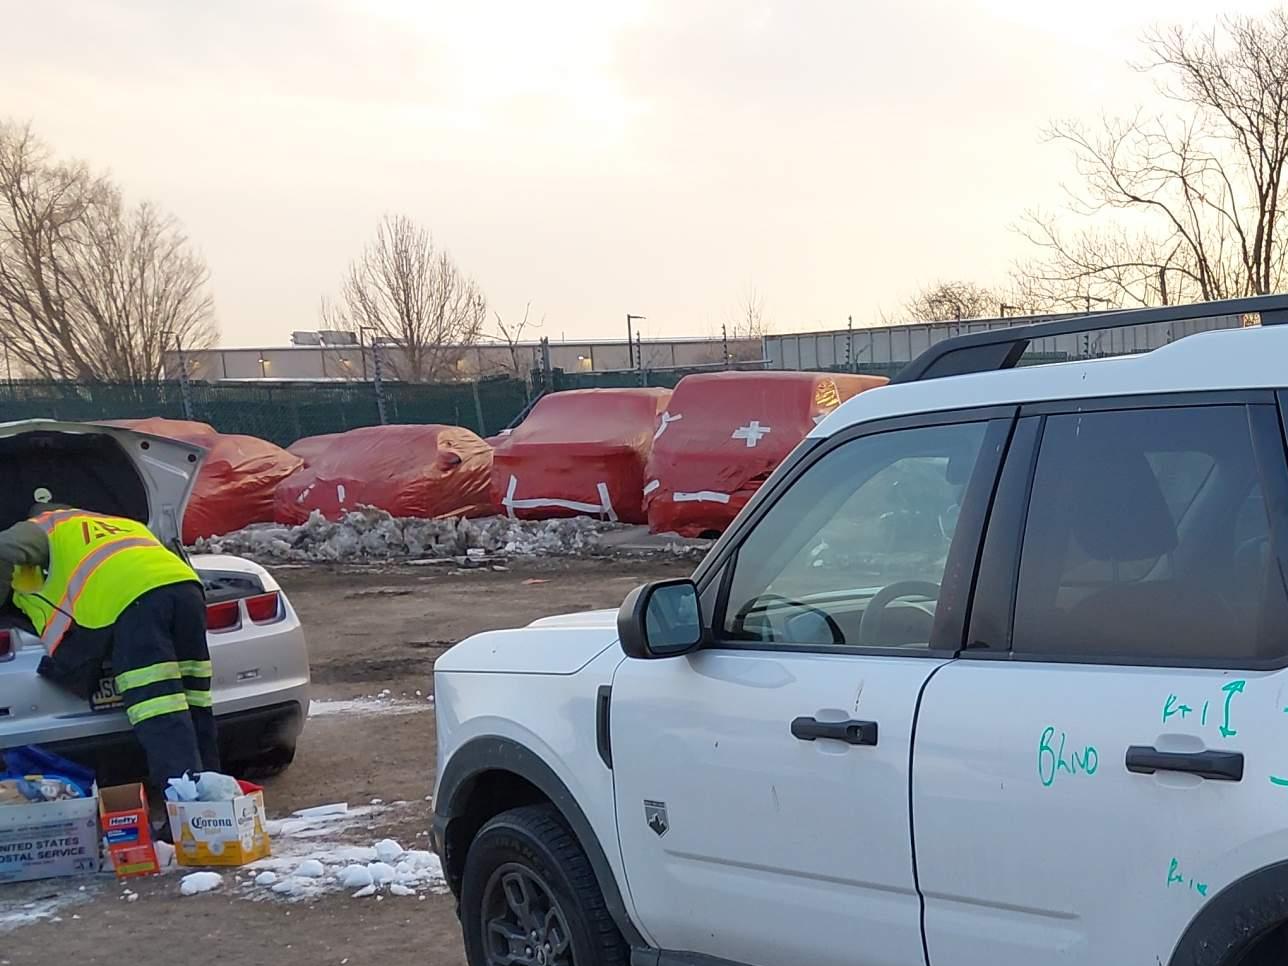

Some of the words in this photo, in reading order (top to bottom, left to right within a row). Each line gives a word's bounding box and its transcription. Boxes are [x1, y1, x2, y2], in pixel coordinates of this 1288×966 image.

[111, 816, 136, 825] Hefty
[191, 816, 232, 829] Corona
[36, 837, 79, 849] STATES
[37, 847, 85, 859] SERVICE
